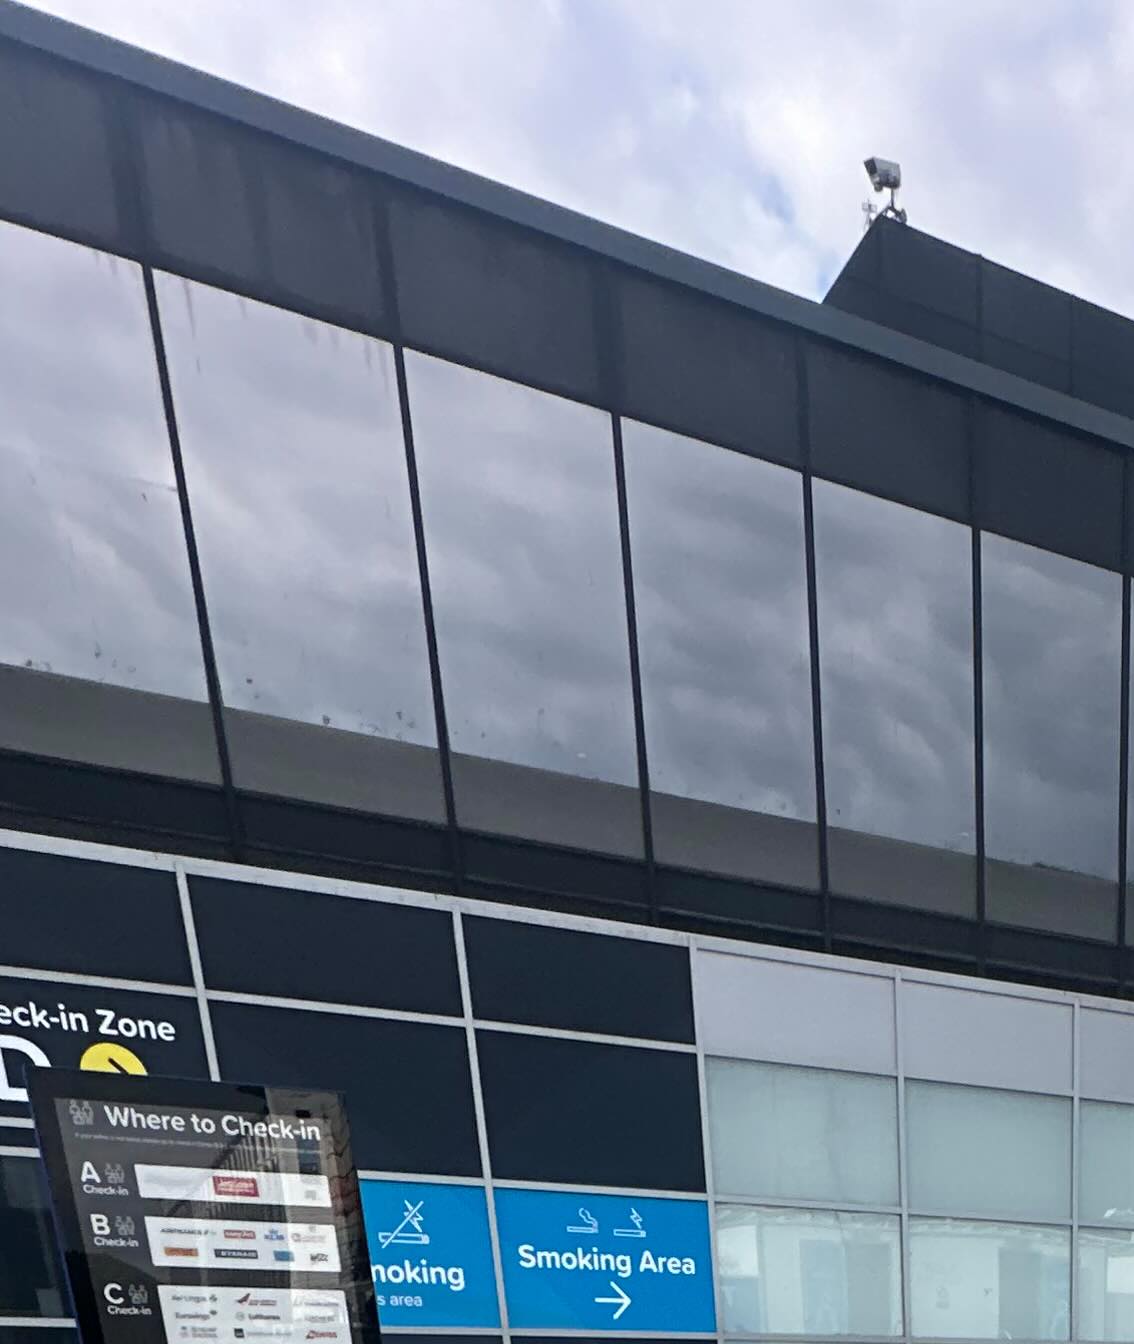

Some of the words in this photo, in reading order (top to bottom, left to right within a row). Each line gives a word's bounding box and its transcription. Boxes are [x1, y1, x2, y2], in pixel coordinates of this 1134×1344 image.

[0, 1001, 90, 1033] eck-in
[95, 1008, 176, 1041] Zone
[103, 1105, 186, 1132] Where
[191, 1113, 216, 1134] to
[221, 1114, 321, 1142] Check-in
[80, 1160, 101, 1184] A
[82, 1183, 129, 1196] Check-in
[90, 1213, 111, 1236] B
[93, 1236, 139, 1248] Check-in
[517, 1244, 633, 1278] Smoking
[639, 1250, 697, 1275] Area
[371, 1259, 465, 1291] moking
[103, 1283, 125, 1305] C
[390, 1295, 423, 1307] area
[106, 1304, 152, 1316] Check-in
